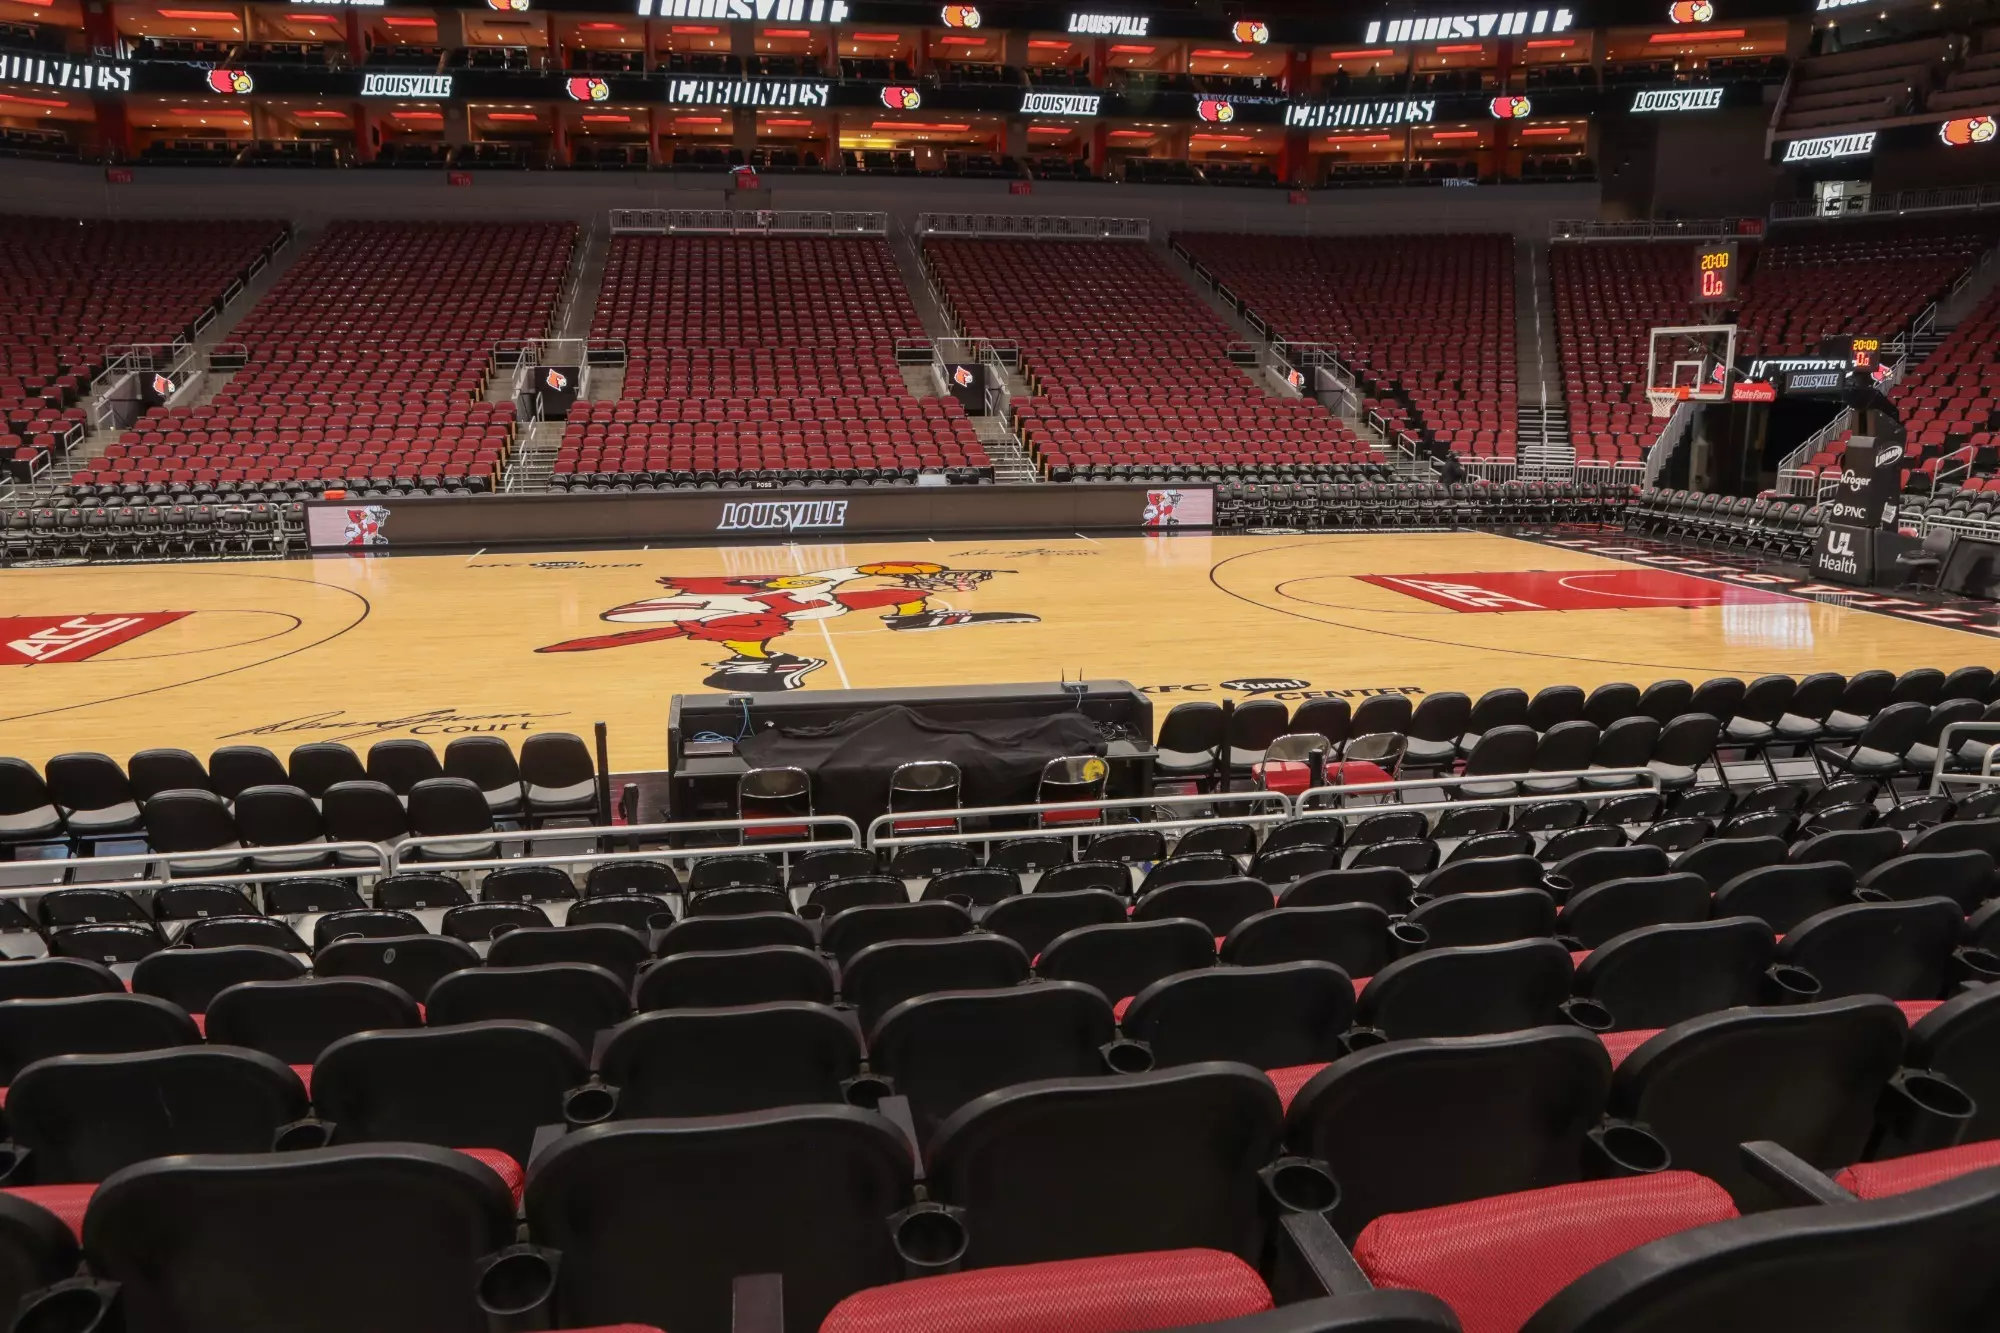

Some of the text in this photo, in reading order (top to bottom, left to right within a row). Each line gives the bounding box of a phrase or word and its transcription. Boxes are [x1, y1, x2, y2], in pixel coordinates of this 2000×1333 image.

[1068, 13, 1149, 36] LOUISVILLE
[361, 74, 453, 97] LOUISVILLE
[1020, 92, 1100, 116] LOUISVILLE
[1630, 87, 1724, 112] LOUISVILLE
[1783, 131, 1877, 162] LOUISVILLE
[1701, 252, 1729, 270] 20:00
[1703, 270, 1723, 296] 0.0
[1853, 339, 1878, 351] 20:00
[1790, 373, 1840, 389] LOUISVILLE
[1841, 469, 1871, 491] Kroger
[716, 500, 849, 533] LOUISVILLE
[1843, 505, 1866, 519] PNC
[1819, 553, 1857, 574] Health
[6, 616, 132, 658] ACC
[1222, 679, 1306, 690] Yum!
[1273, 686, 1427, 701] CENTER
[409, 721, 536, 735] Court
